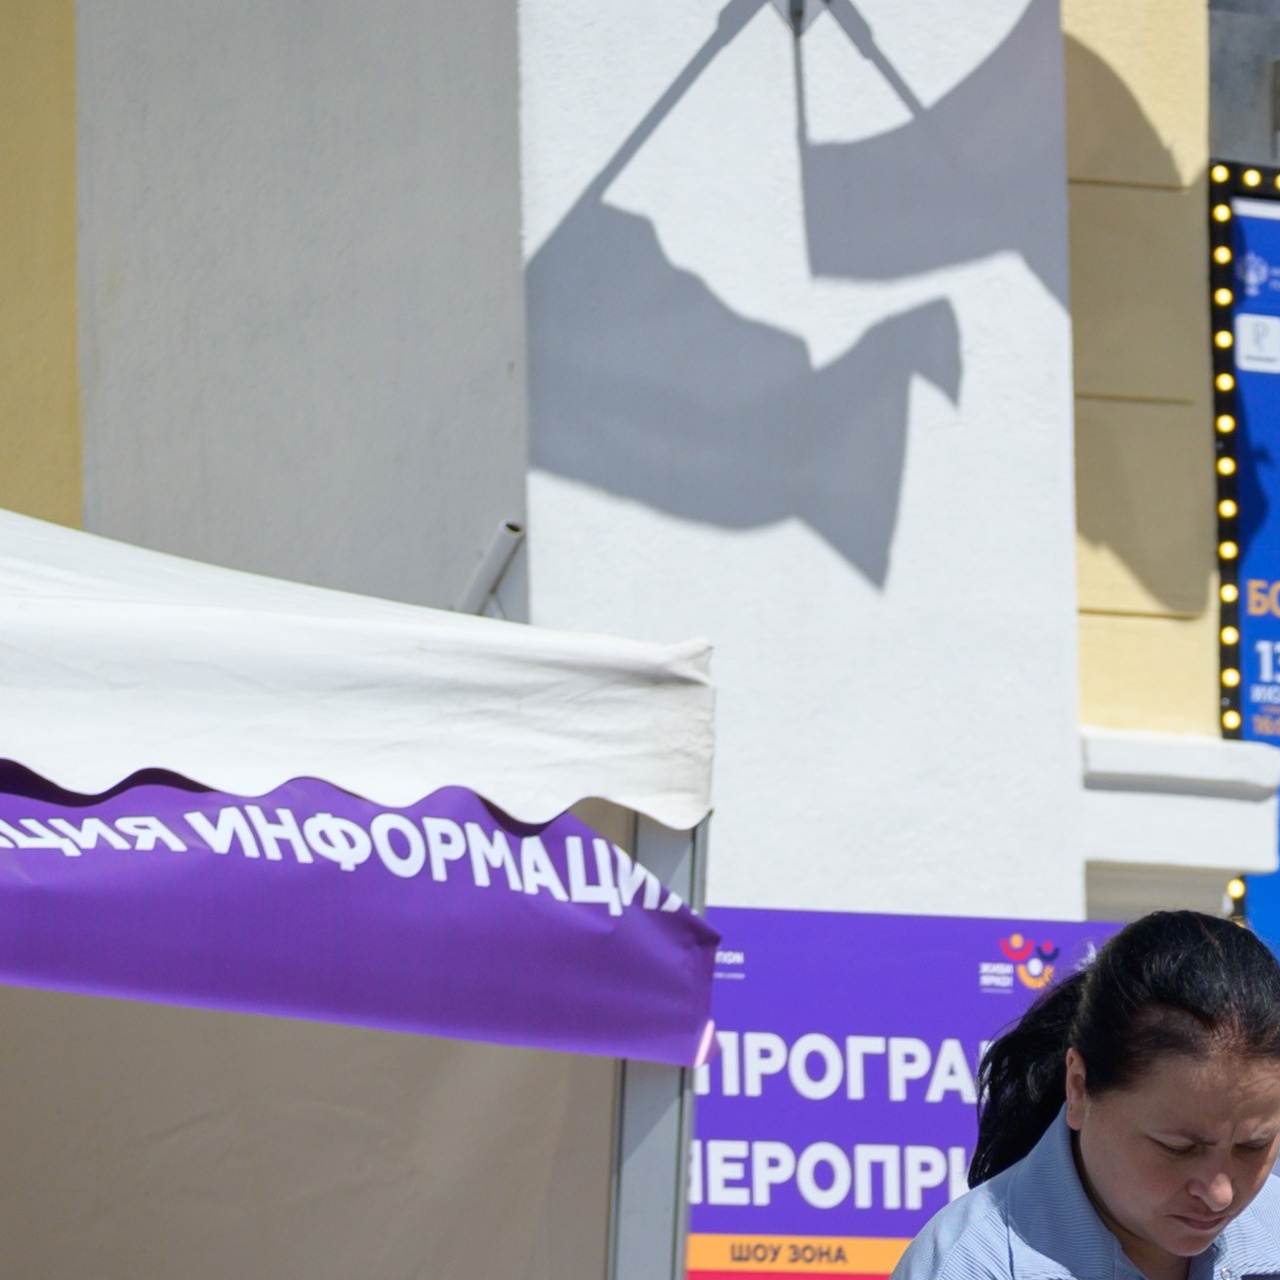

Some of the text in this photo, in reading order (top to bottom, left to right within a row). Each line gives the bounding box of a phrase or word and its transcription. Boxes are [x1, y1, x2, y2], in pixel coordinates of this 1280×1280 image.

[0, 804, 700, 917] ЦИЯ ИНФОРМАЦИ
[694, 1031, 990, 1105] ПРОГРА
[730, 1244, 847, 1264] ШОУ ЗОНА
